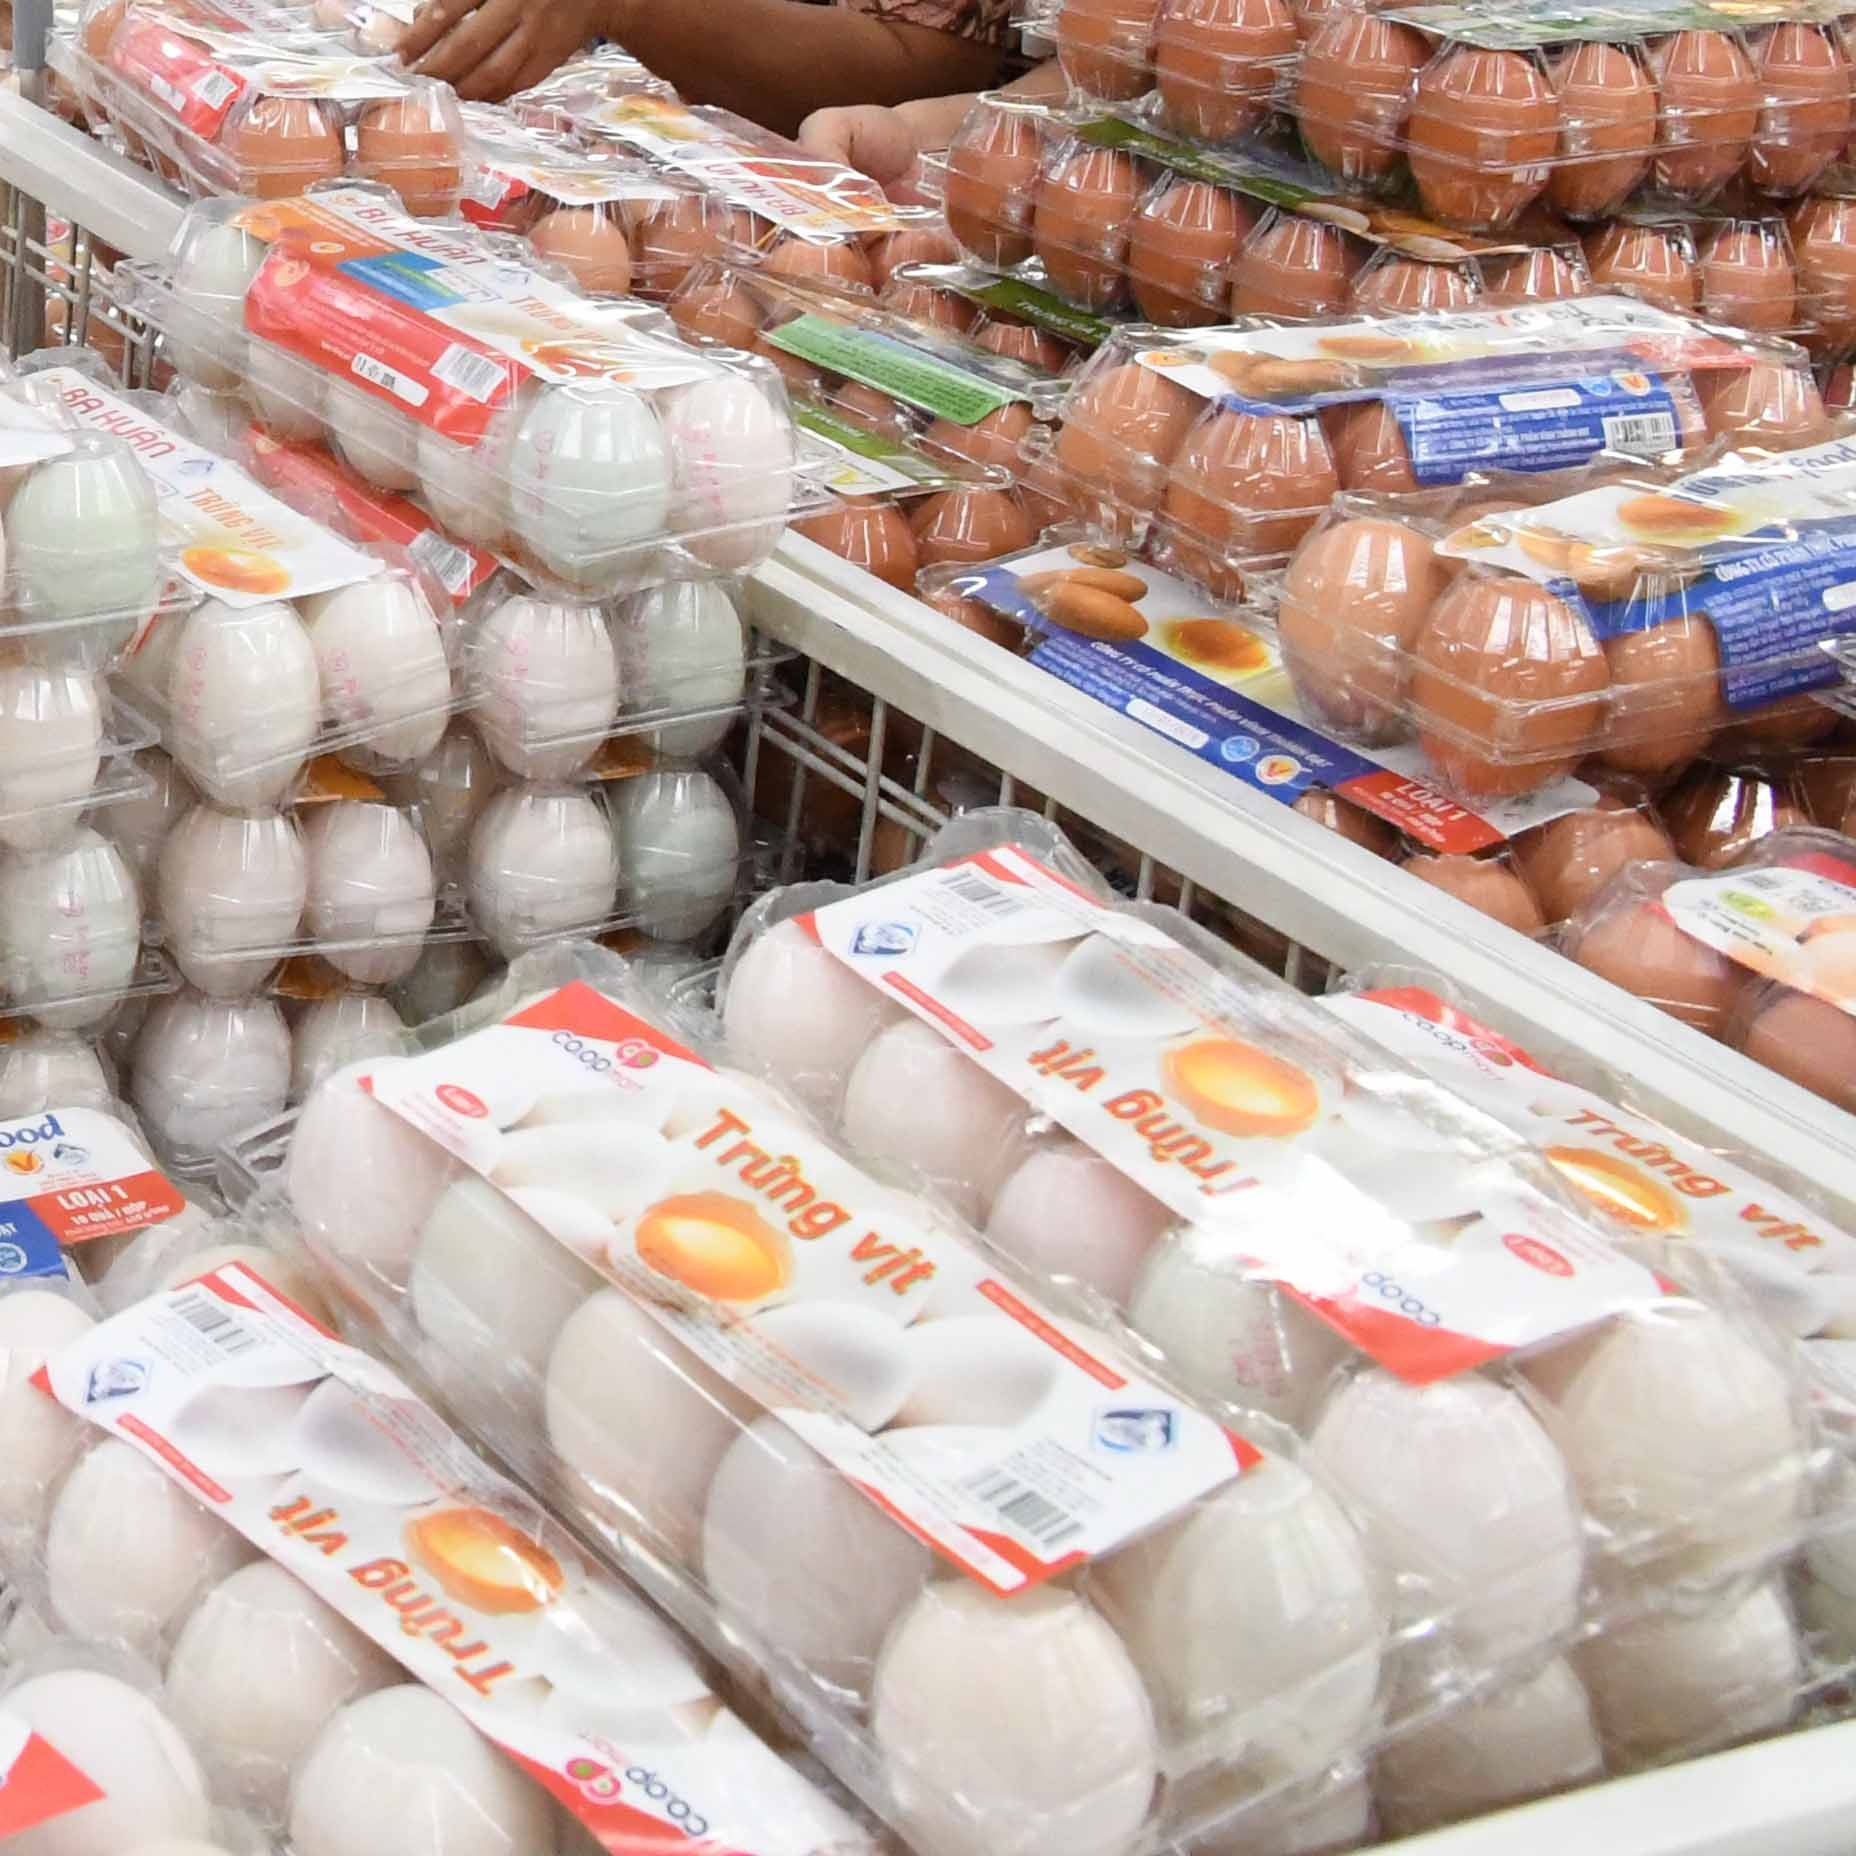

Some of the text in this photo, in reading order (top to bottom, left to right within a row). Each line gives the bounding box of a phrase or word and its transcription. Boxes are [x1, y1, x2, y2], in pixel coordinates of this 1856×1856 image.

[63, 387, 105, 415] BA
[57, 1187, 107, 1213] LOẠI
[691, 1109, 941, 1297] Trứng vịt
[1566, 1109, 1828, 1254] Trứng vịt
[267, 1493, 517, 1697] vịt Trứng
